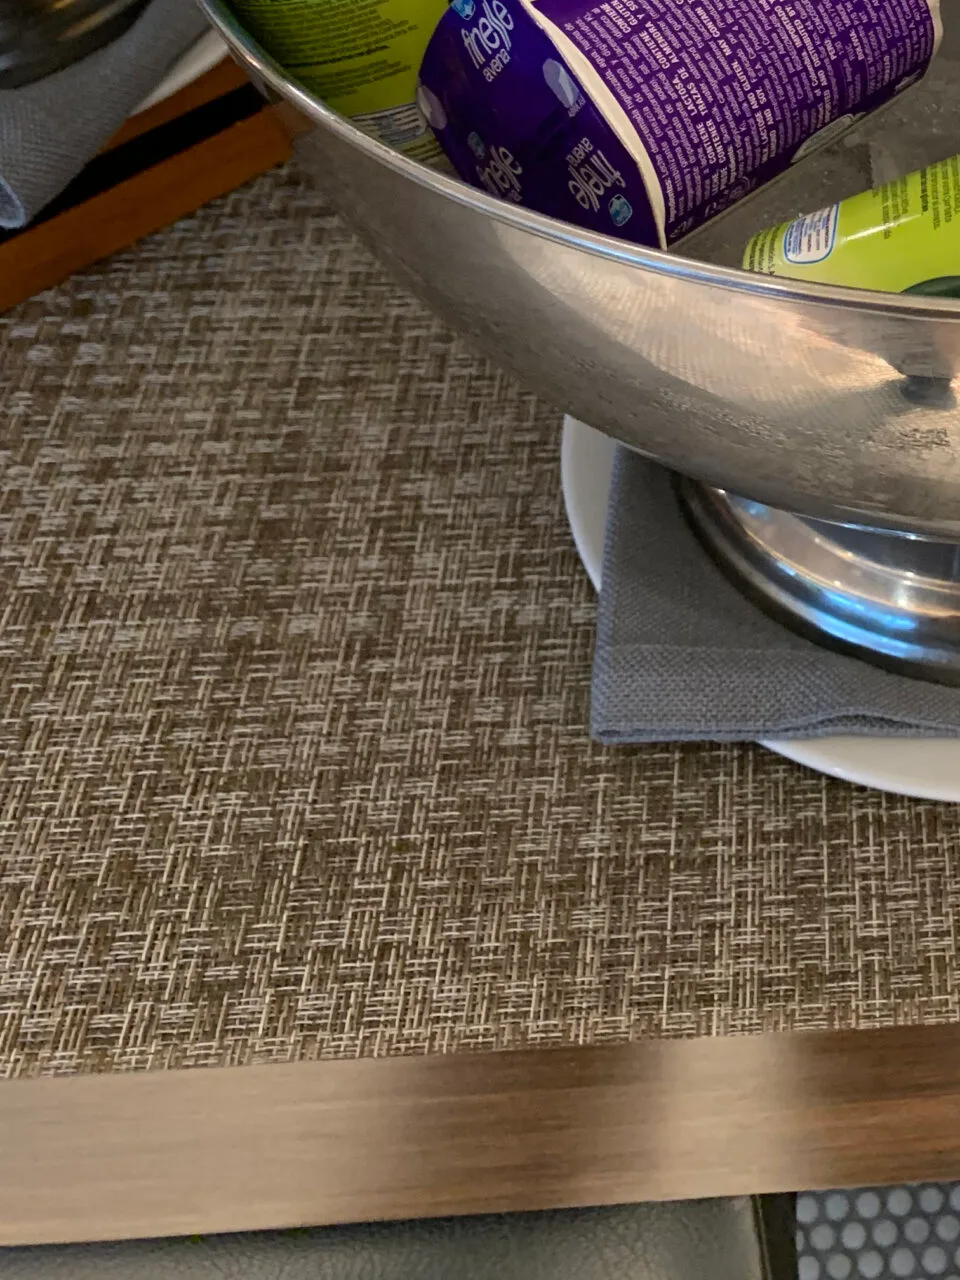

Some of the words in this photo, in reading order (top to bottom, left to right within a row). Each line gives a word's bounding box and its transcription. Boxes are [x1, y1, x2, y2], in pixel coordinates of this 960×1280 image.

[563, 21, 575, 31] de
[599, 1, 631, 33] CONTIENE
[694, 5, 721, 38] CONTAIN
[773, 4, 802, 48] IMPORTADO
[620, 40, 639, 61] sabor
[638, 29, 670, 70] CONTIENE
[644, 20, 679, 64] ALMENDRA
[657, 19, 682, 49] stabilizer
[716, 37, 732, 56] MAY
[792, 18, 821, 67] DISTRIBUTED
[482, 47, 512, 82] avena
[615, 67, 635, 90] mono
[619, 56, 644, 84] artificial
[631, 91, 643, 104] de
[639, 82, 669, 126] edulcorante
[662, 102, 674, 115] de
[669, 73, 698, 116] LACTOSA,
[686, 81, 709, 116] TRAZAS
[745, 90, 759, 109] AND
[630, 108, 659, 154] descremada
[641, 105, 664, 138] (mezcla
[753, 109, 768, 144] LACTOSE
[763, 107, 775, 126] AND
[695, 121, 716, 164] CONTIENE
[704, 118, 726, 163] CONTENER
[654, 152, 669, 178] Leche
[659, 140, 684, 192] estabilizante
